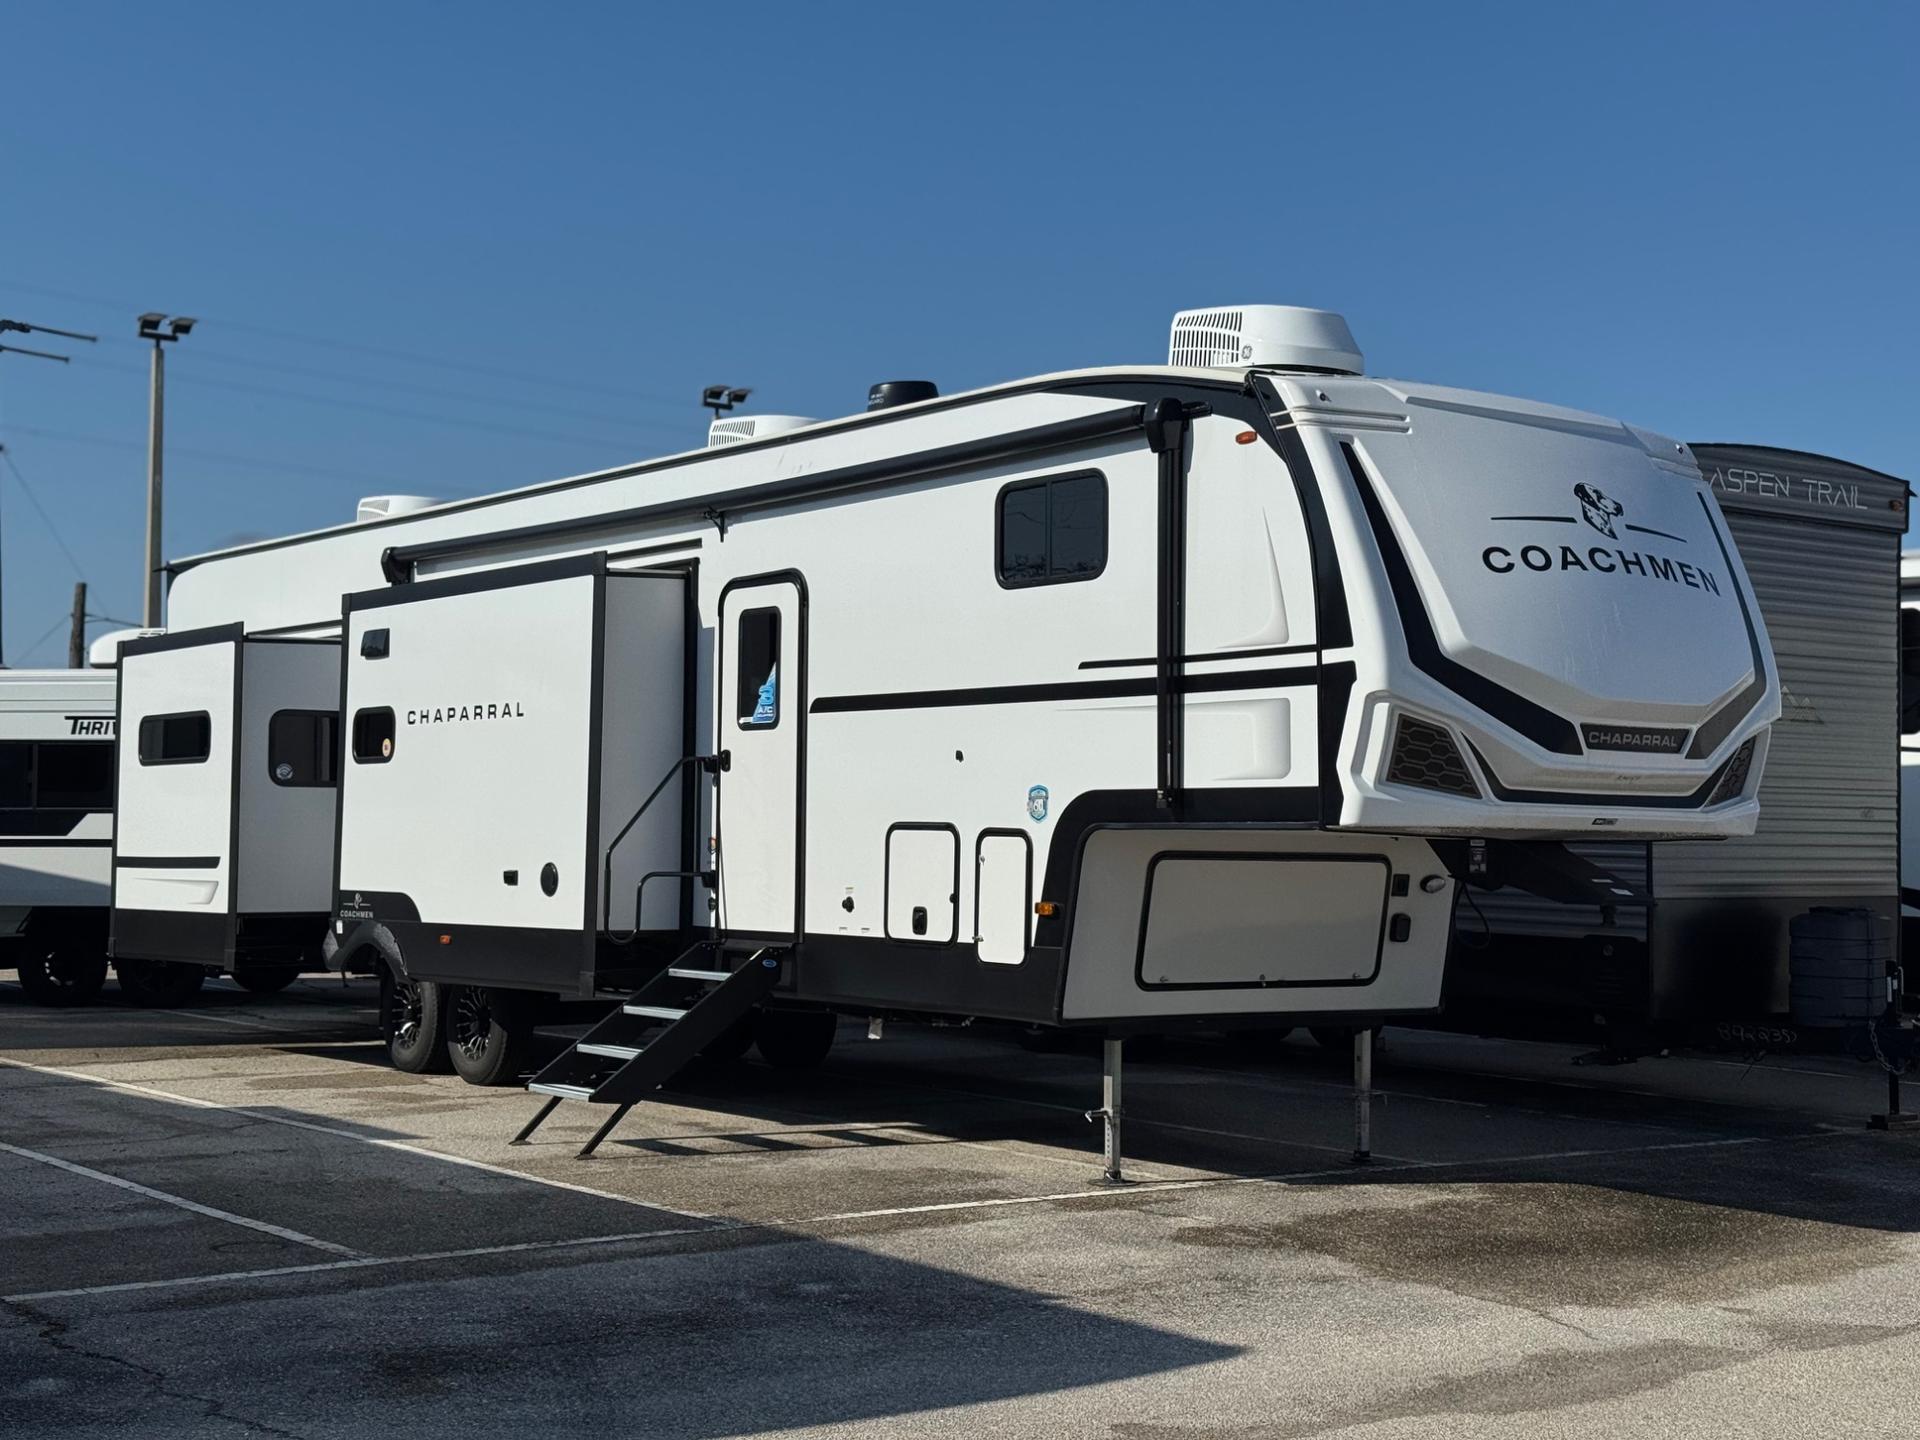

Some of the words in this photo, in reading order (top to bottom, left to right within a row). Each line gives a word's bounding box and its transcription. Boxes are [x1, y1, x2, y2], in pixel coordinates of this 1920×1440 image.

[1708, 467, 1790, 498] ASPEN
[1802, 478, 1868, 510] TRAIL
[1481, 544, 1721, 597] COACHMEN
[407, 701, 525, 726] CHAPARRAL
[64, 715, 116, 736] THRI
[1587, 730, 1679, 748] CHAPARRAL
[340, 910, 374, 919] COACHMEN
